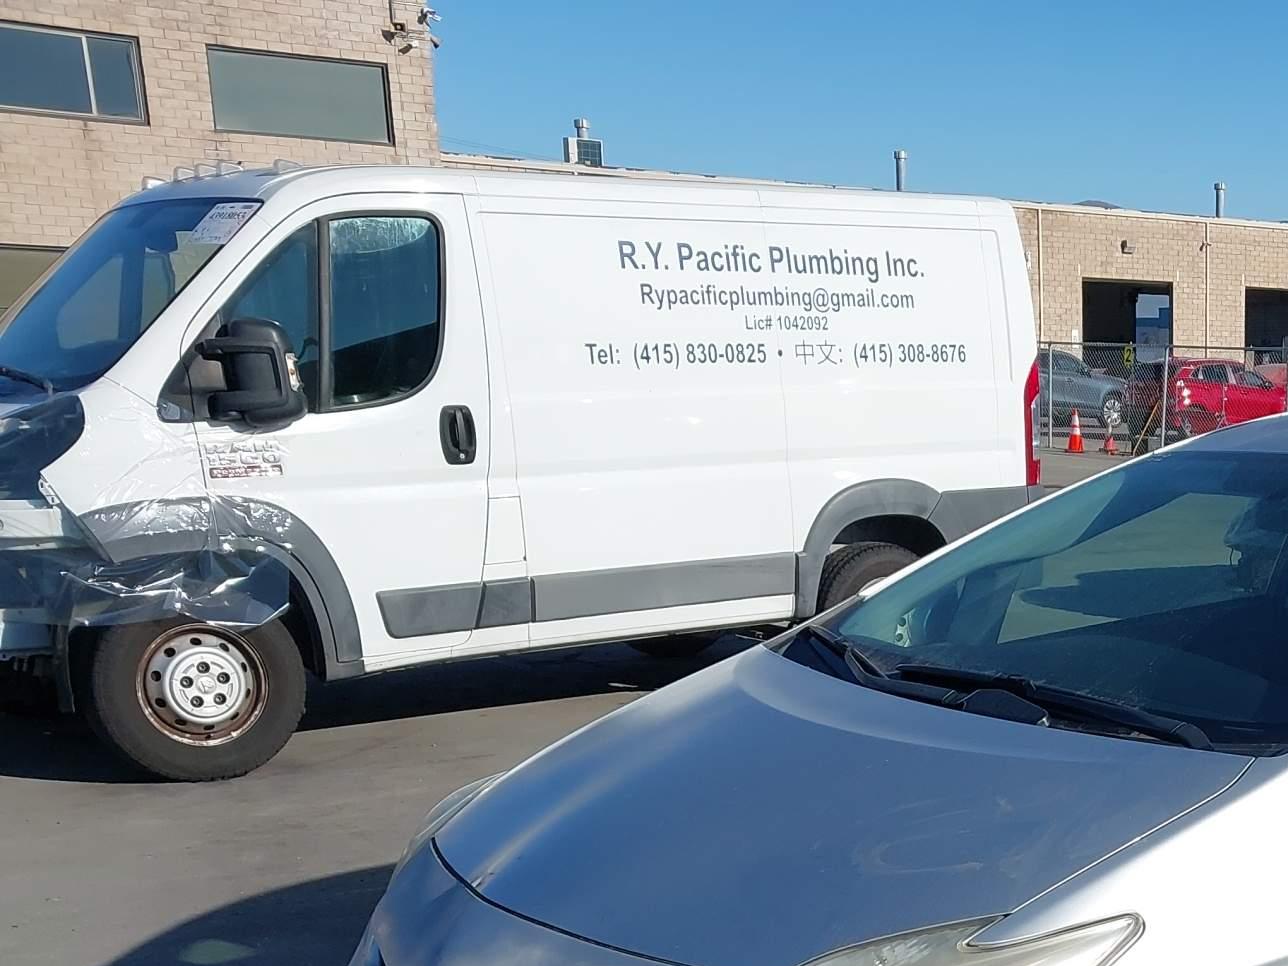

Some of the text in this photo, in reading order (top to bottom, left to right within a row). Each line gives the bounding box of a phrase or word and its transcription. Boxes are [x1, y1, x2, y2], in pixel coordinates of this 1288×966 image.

[617, 240, 924, 283] R.Y. Pacific Plumbing Inc.
[640, 283, 914, 313] Rypacificplumbing@gmail.com
[744, 315, 828, 331] Lic# 1042092
[584, 343, 620, 366] Tel:
[634, 343, 680, 370] (415)
[686, 343, 767, 364] 830-0825
[853, 343, 893, 369] (415)
[898, 344, 966, 364] 308-8676
